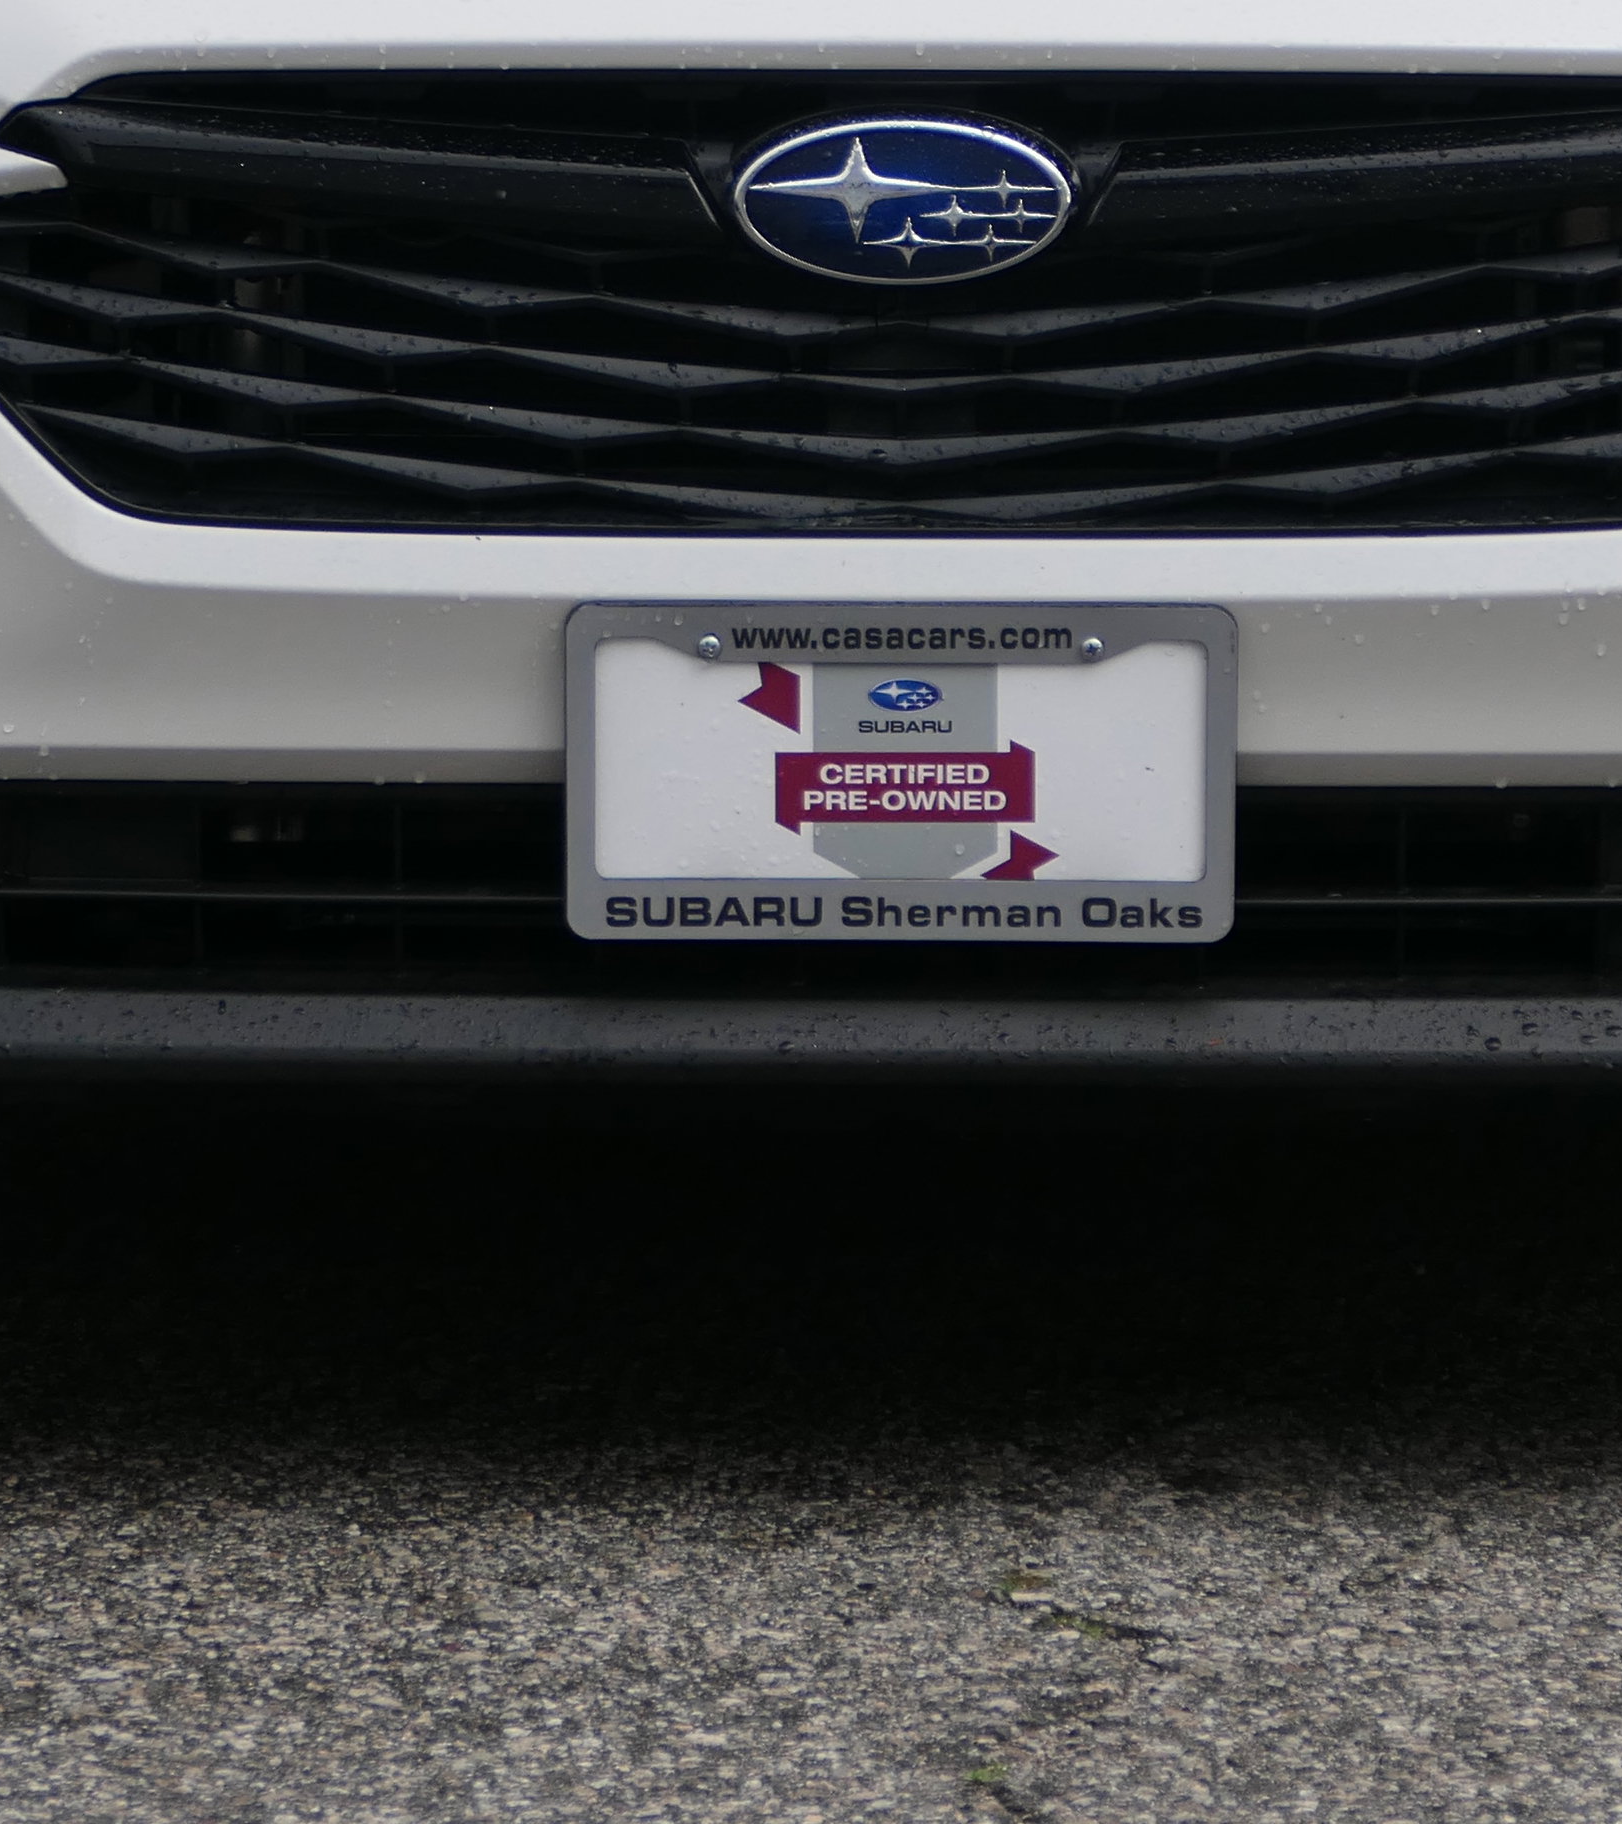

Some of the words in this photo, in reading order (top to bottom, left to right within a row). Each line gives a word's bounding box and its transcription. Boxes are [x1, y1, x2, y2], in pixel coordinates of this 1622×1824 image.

[732, 626, 1073, 651] www.casacars.com
[859, 720, 952, 734] SUBARU
[819, 763, 990, 785] CERTIFIED
[803, 790, 1007, 811] PRE-OWNED
[606, 896, 823, 928] SUBARU
[841, 896, 1061, 928] Sherman
[1082, 897, 1203, 928] Oaks
